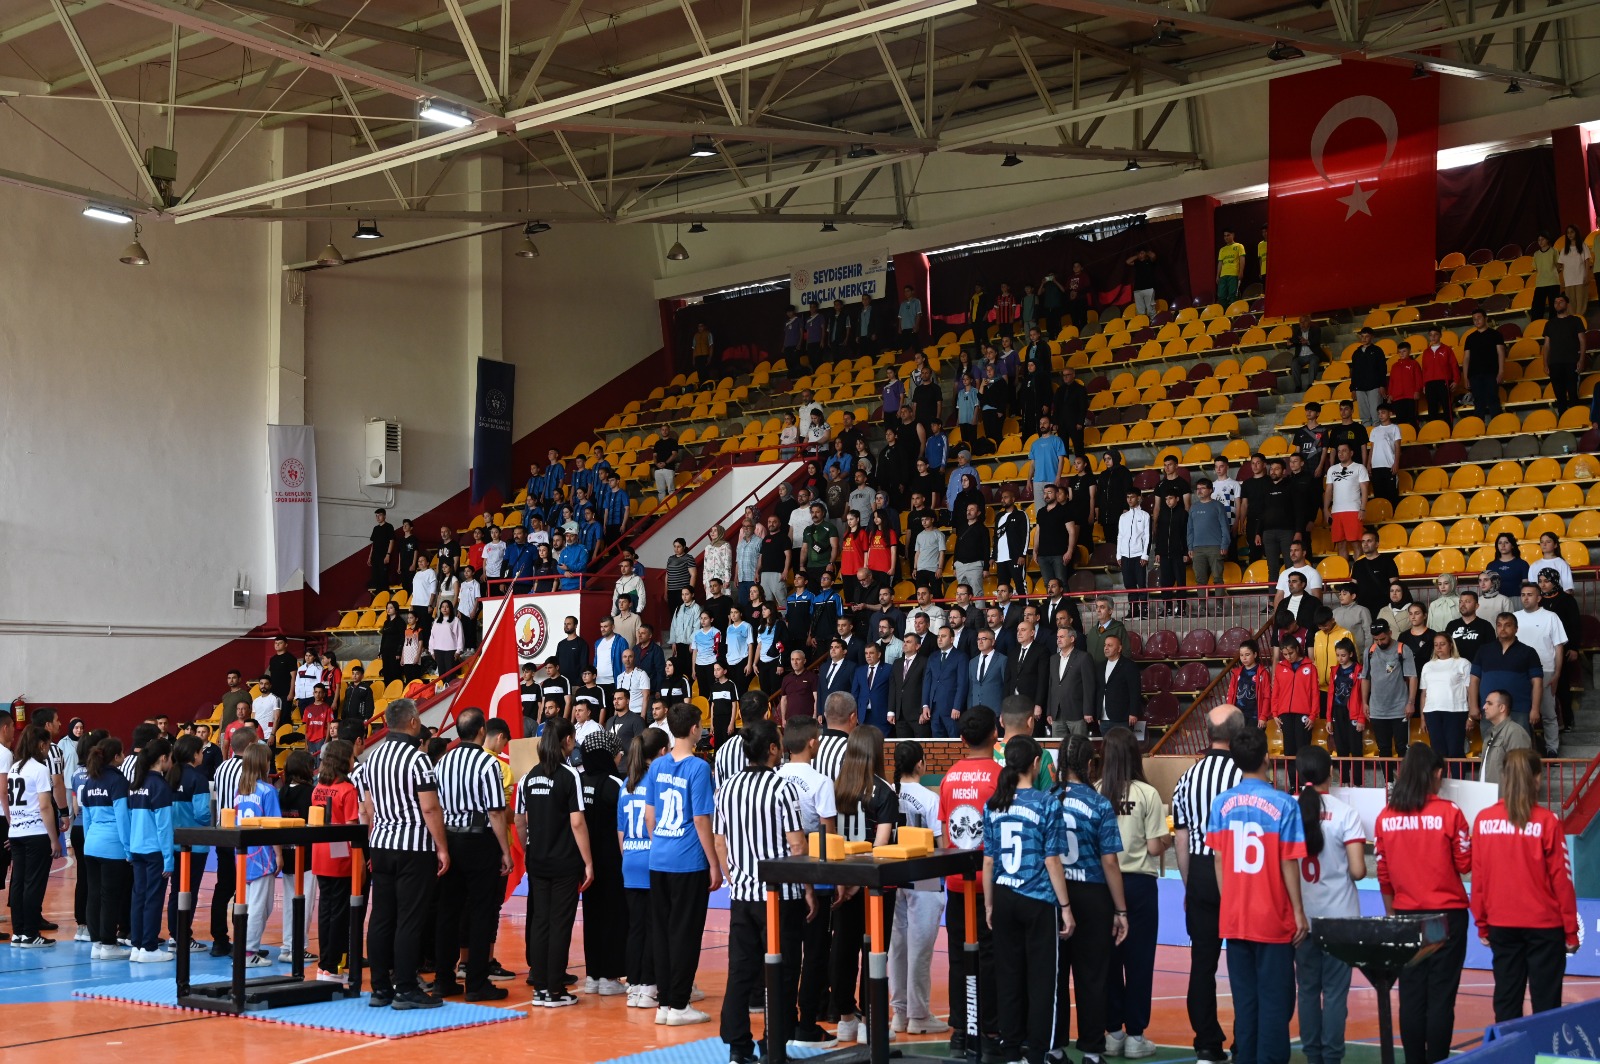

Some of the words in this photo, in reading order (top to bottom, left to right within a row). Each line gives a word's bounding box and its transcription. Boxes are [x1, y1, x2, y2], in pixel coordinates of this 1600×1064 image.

[814, 263, 863, 285] SEYDİŞEHİR
[801, 287, 837, 305] GENÇLİK
[839, 280, 876, 298] MERKEZİ
[962, 769, 982, 783] GENÇLİK
[952, 786, 978, 799] MERSİN
[623, 800, 646, 839] 17
[660, 787, 683, 830] 10
[1381, 816, 1419, 832] KOZAN
[1421, 815, 1443, 830] YBO
[1479, 820, 1516, 835] KOZAN
[1000, 821, 1023, 875] 5
[1229, 820, 1265, 874] 16
[966, 974, 978, 1037] WHITEFACE
